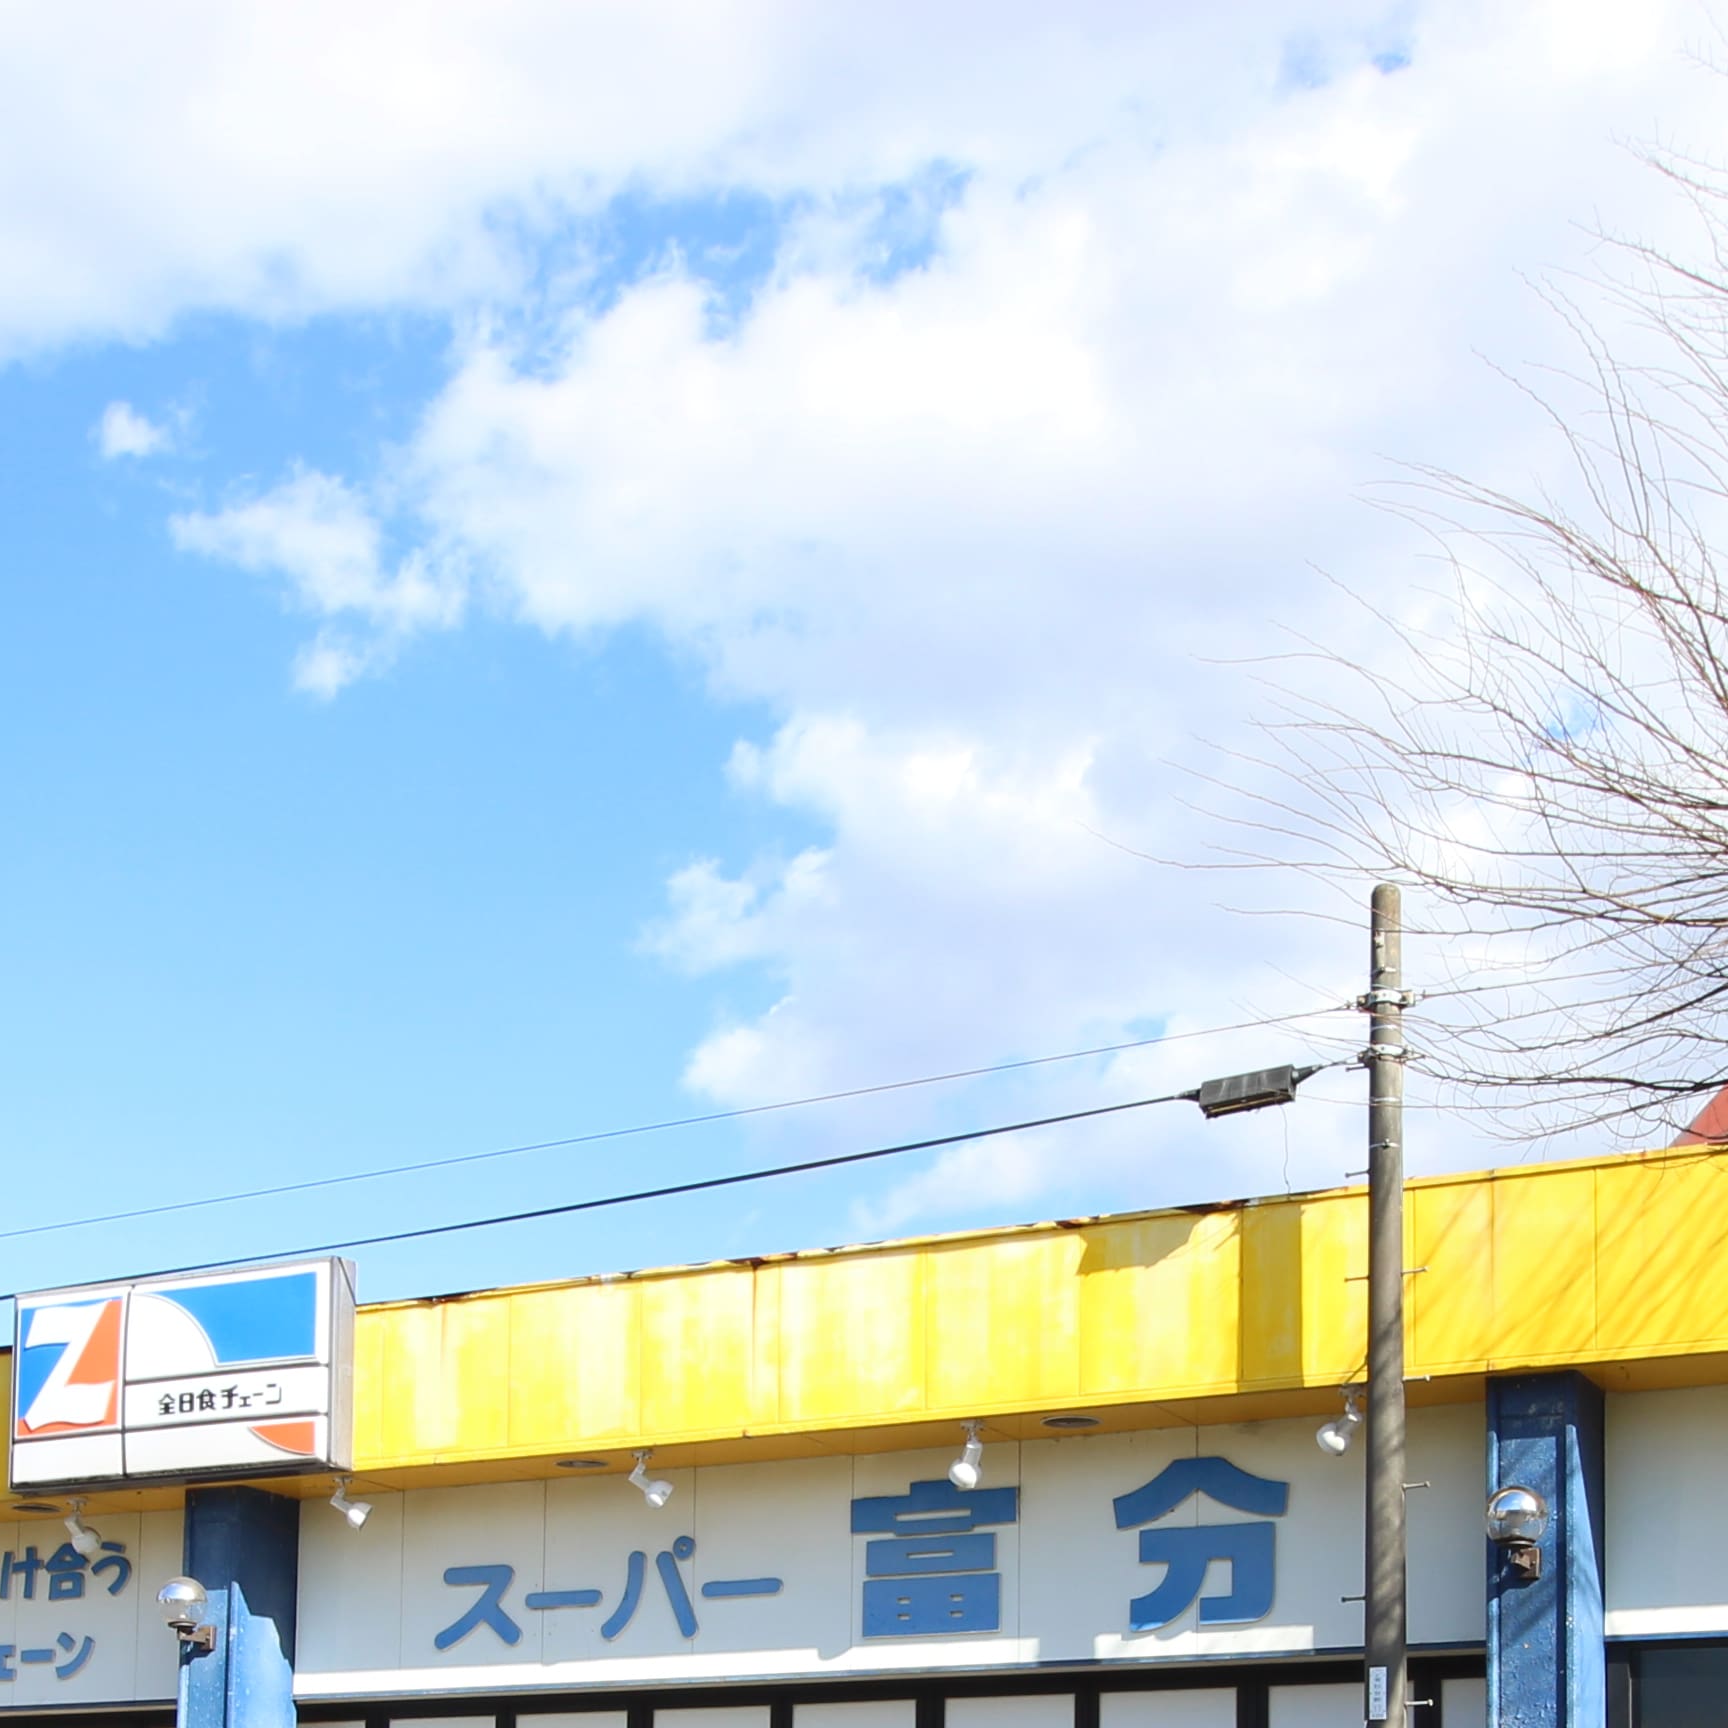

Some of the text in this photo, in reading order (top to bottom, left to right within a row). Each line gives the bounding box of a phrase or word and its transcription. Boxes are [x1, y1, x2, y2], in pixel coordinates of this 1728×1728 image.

[158, 1384, 282, 1416] 全日食チェーン
[433, 1535, 785, 1652] スーパー
